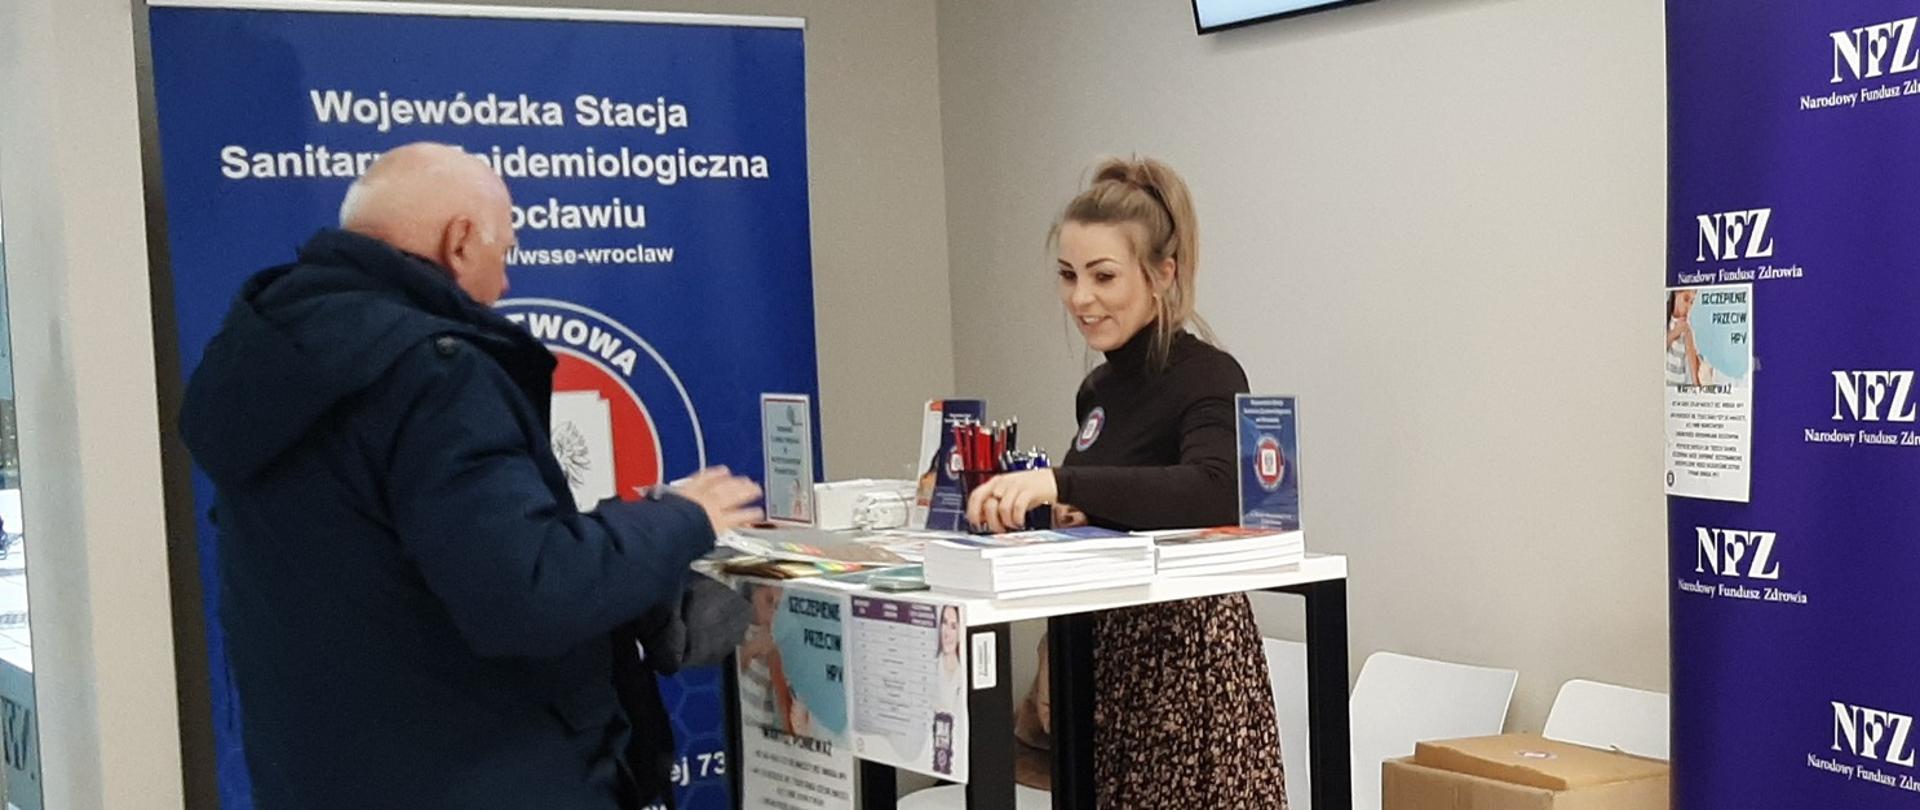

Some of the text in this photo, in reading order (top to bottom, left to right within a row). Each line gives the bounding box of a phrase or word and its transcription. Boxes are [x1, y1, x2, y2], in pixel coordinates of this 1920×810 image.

[1829, 16, 1919, 84] NFZ
[310, 89, 689, 135] Wojewódzka Stacja
[1800, 91, 1858, 111] Narodowy
[1861, 85, 1901, 103] Fundusz
[510, 197, 647, 230] ocławiu
[1695, 207, 1774, 262] NFZ
[1719, 267, 1756, 282] Fundusz
[1758, 263, 1804, 280] Zdrowia
[1712, 311, 1747, 325] PRZECIW
[1730, 331, 1747, 345] HPV
[1831, 370, 1917, 422] NFZ
[1804, 428, 1856, 448] Narodowy
[1859, 429, 1899, 445] Fundusz
[1695, 526, 1780, 580] NFZ
[1678, 578, 1808, 605] Narodowy Fundusz Zdrowia
[1830, 701, 1916, 768] NFZ
[1807, 752, 1855, 781] Narodowy
[1856, 763, 1897, 788] Fundusz
